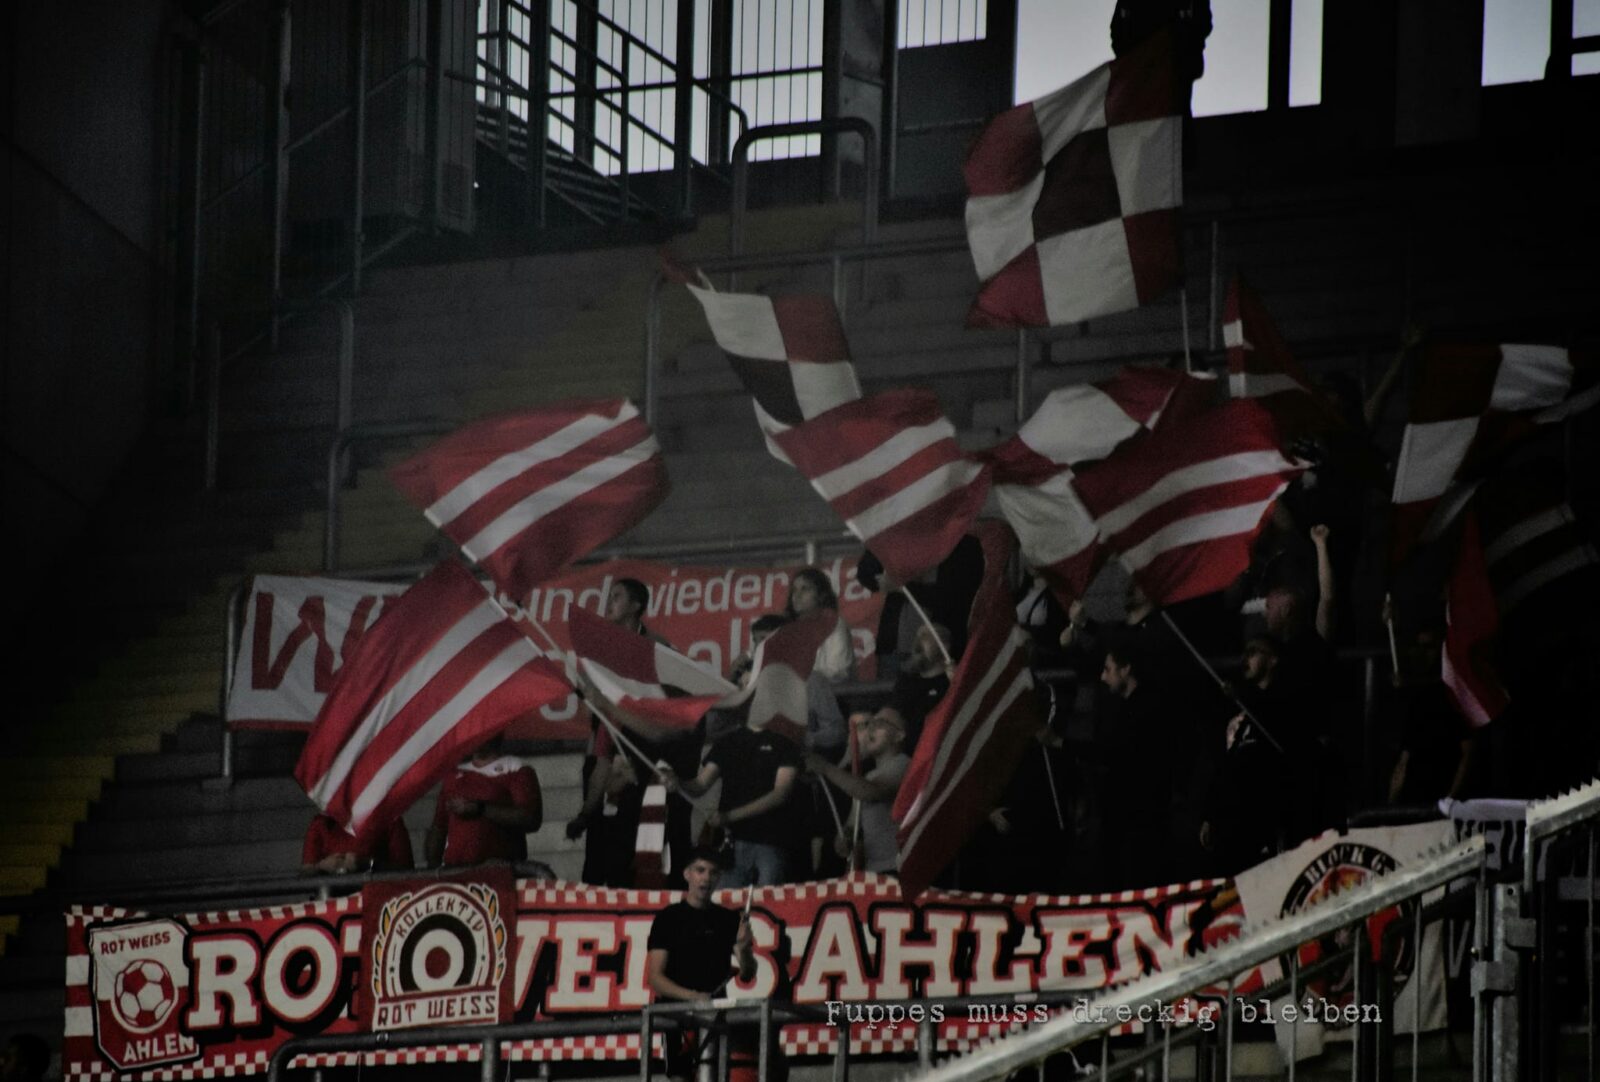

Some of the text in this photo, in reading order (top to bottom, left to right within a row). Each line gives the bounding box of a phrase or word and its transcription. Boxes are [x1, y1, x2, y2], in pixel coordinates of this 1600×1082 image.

[396, 896, 484, 939] KOLLEKTIV
[101, 930, 171, 955] ROT WEISS
[187, 922, 363, 1029] RO
[795, 901, 1205, 1002] AHLEN
[377, 995, 496, 1027] ROT WEISS
[121, 1033, 197, 1064] AHLEN
